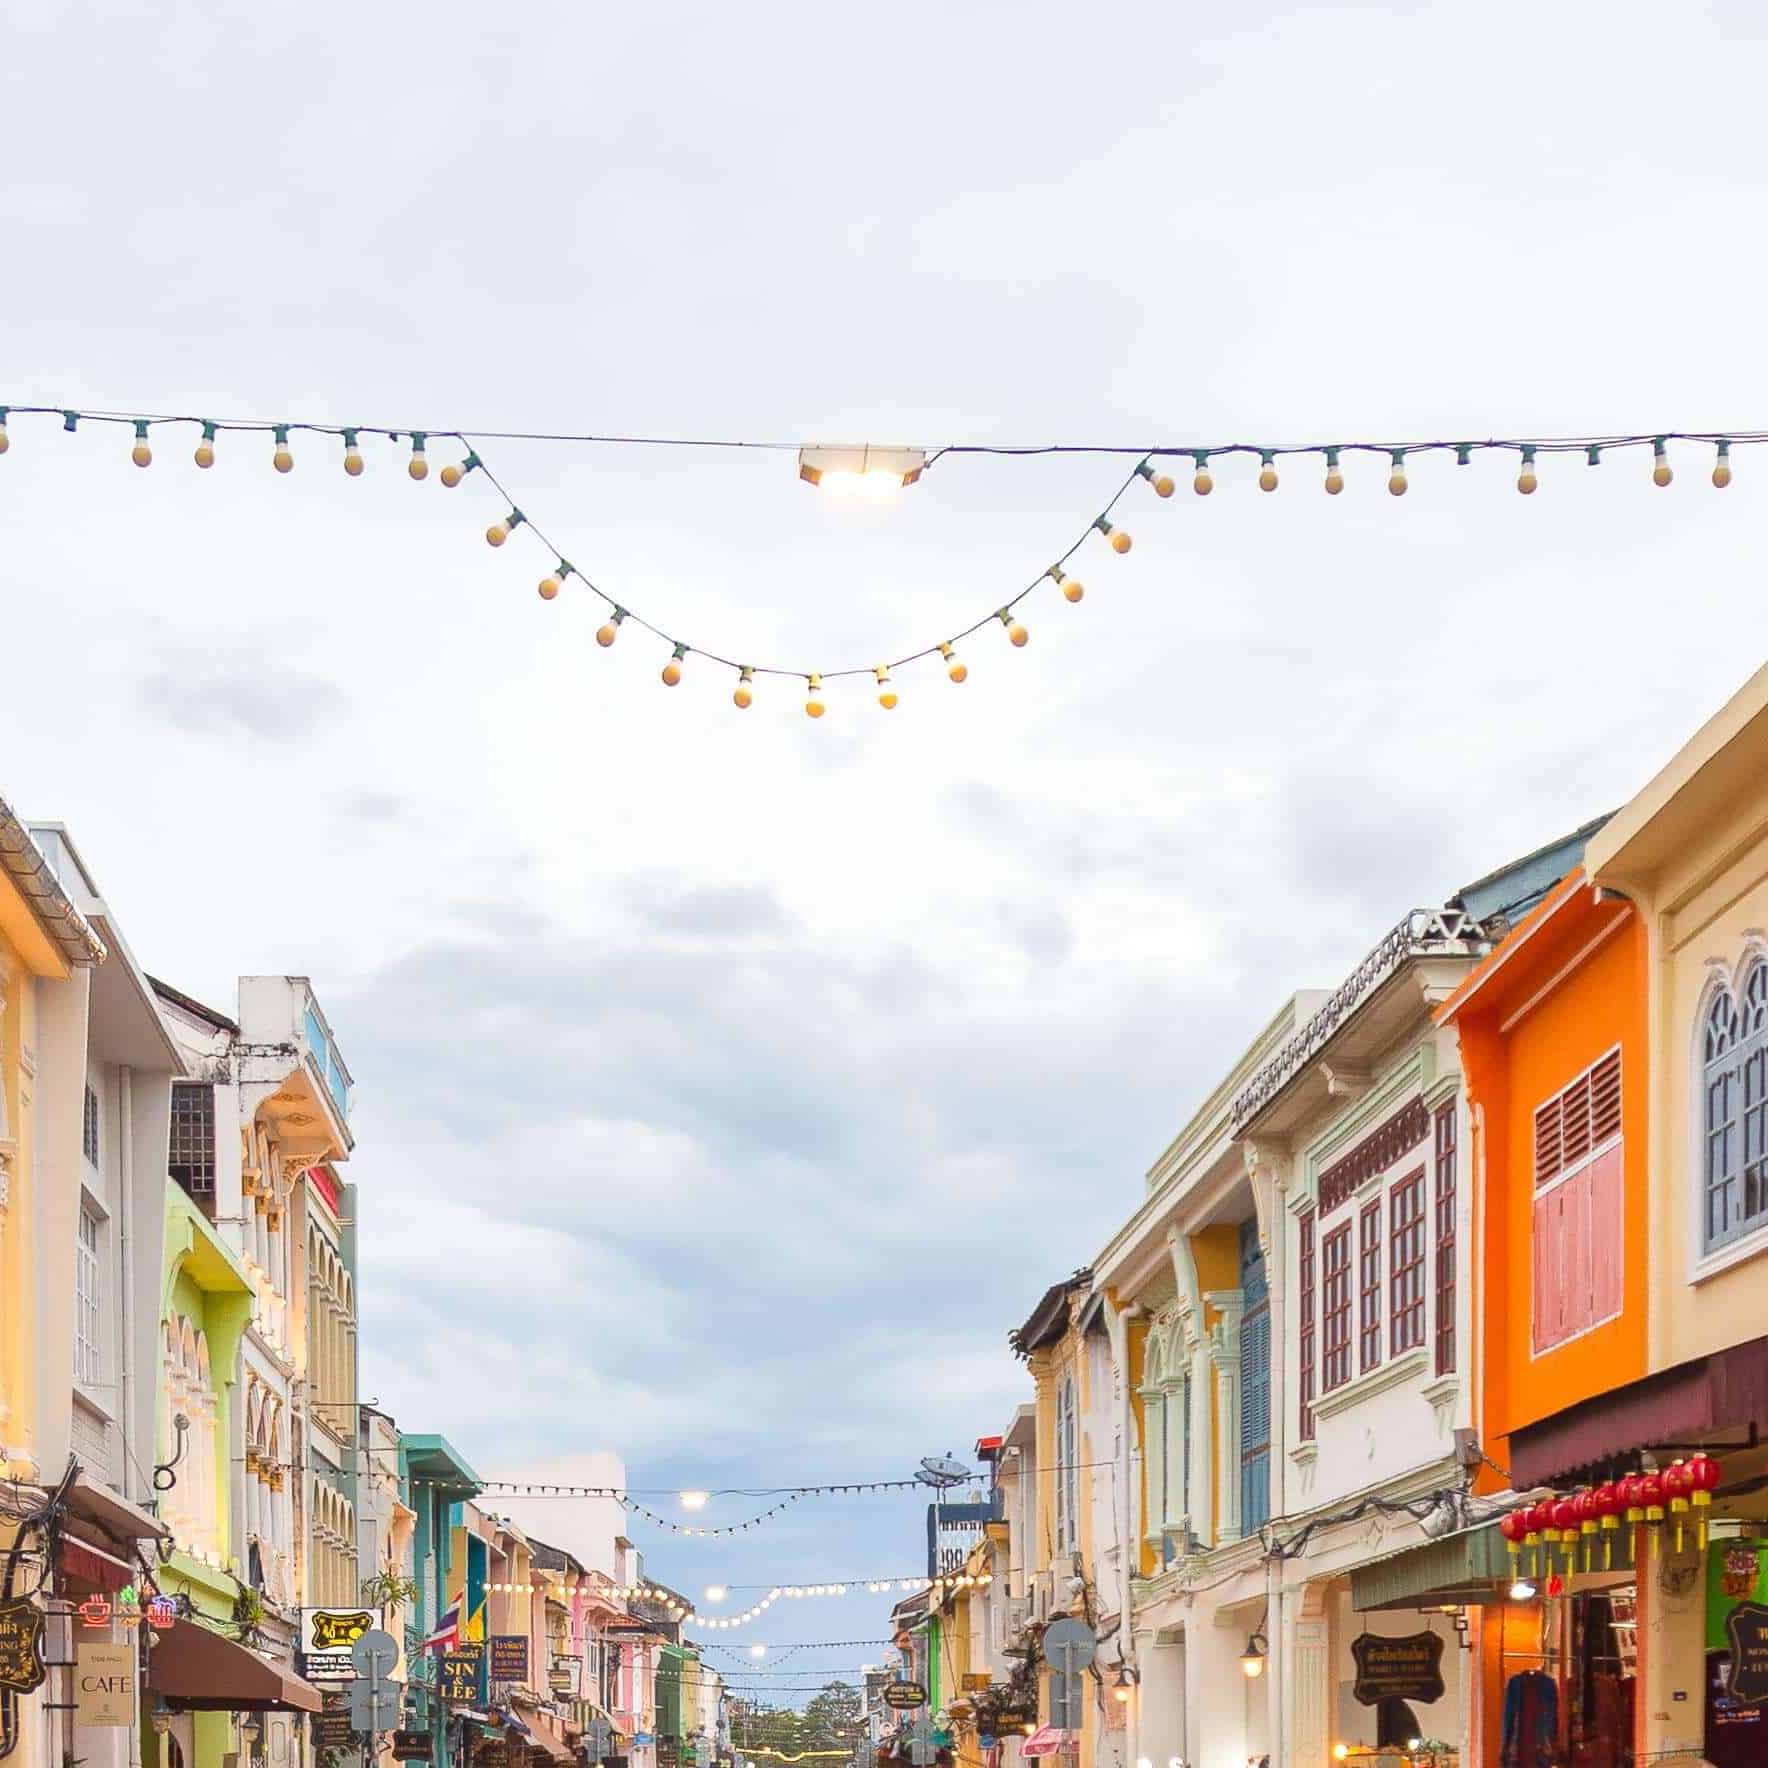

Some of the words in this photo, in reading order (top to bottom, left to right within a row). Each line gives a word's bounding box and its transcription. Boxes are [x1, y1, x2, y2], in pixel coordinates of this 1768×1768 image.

[445, 1663, 476, 1677] SIN
[81, 1676, 133, 1694] CAFE
[440, 1684, 478, 1699] LEE
